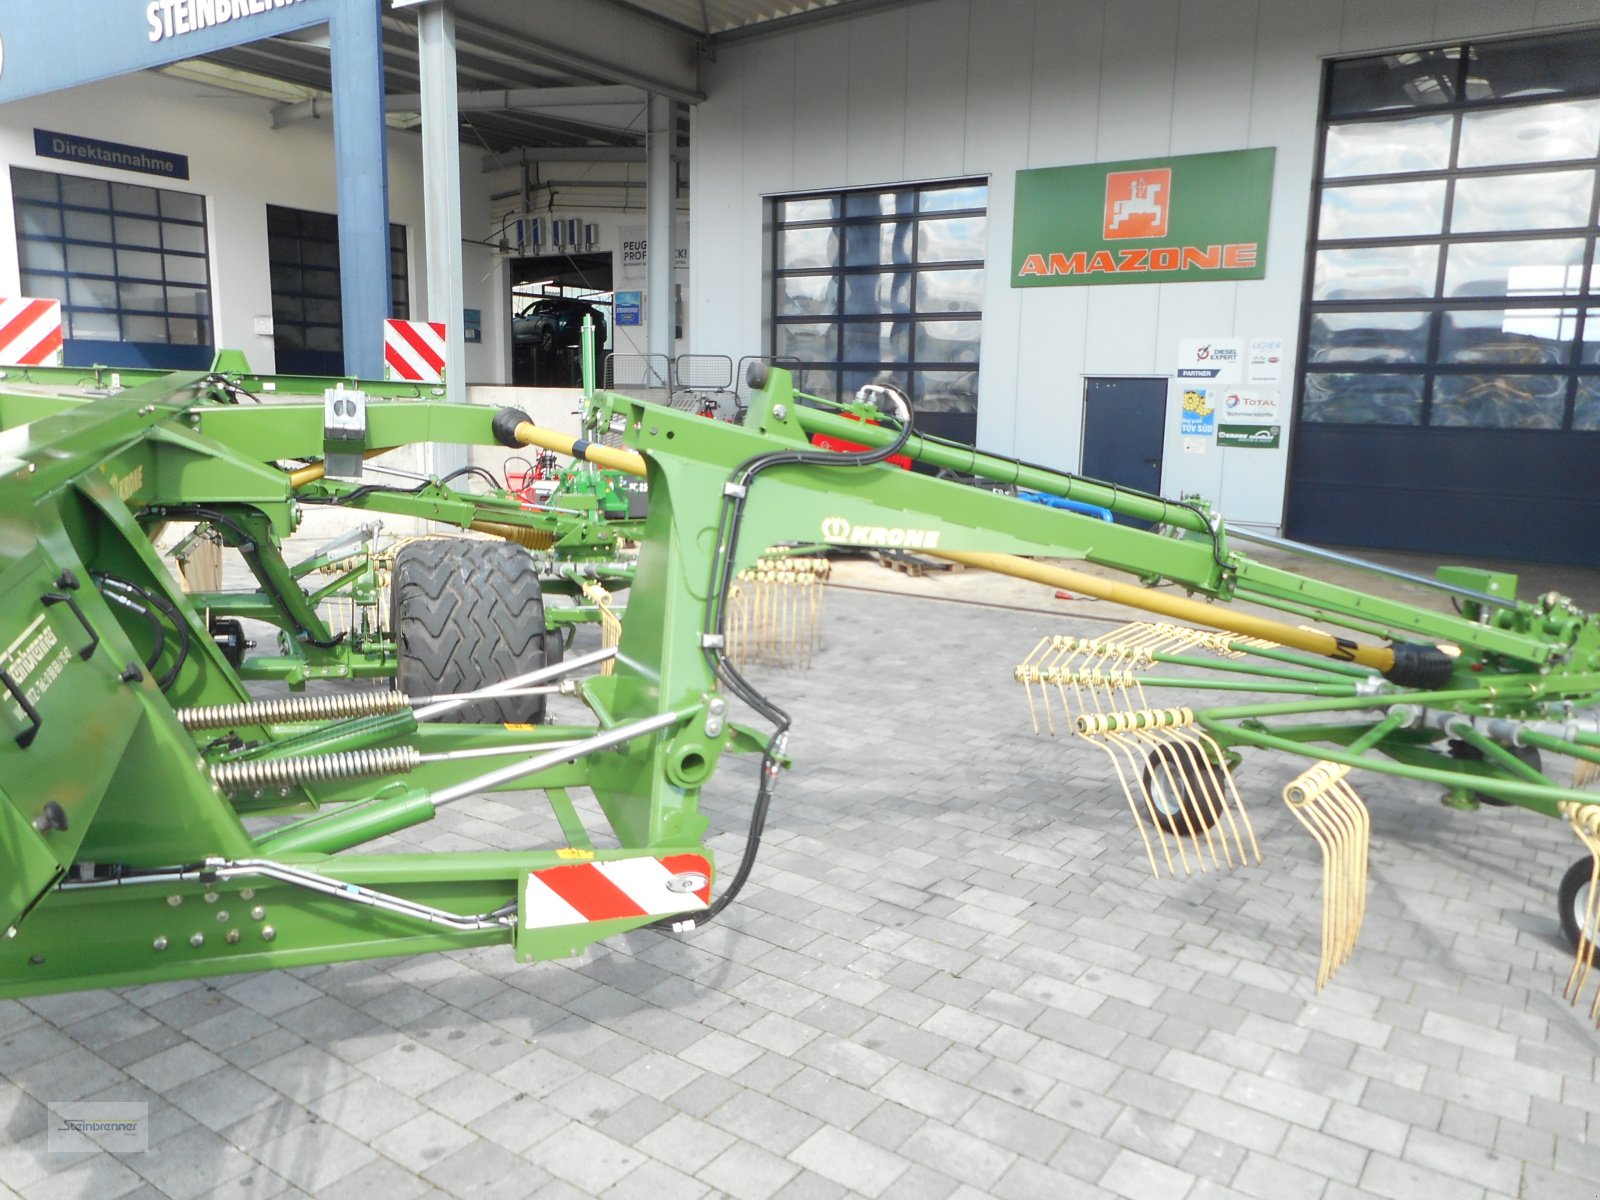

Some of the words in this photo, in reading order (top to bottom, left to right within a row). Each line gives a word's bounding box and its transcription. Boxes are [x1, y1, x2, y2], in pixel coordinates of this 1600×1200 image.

[52, 138, 174, 173] Direktannahme
[1018, 243, 1257, 276] AMAZONE
[1243, 398, 1277, 406] TOTAL
[1197, 424, 1213, 433] SÜD
[849, 525, 940, 548] KRONE
